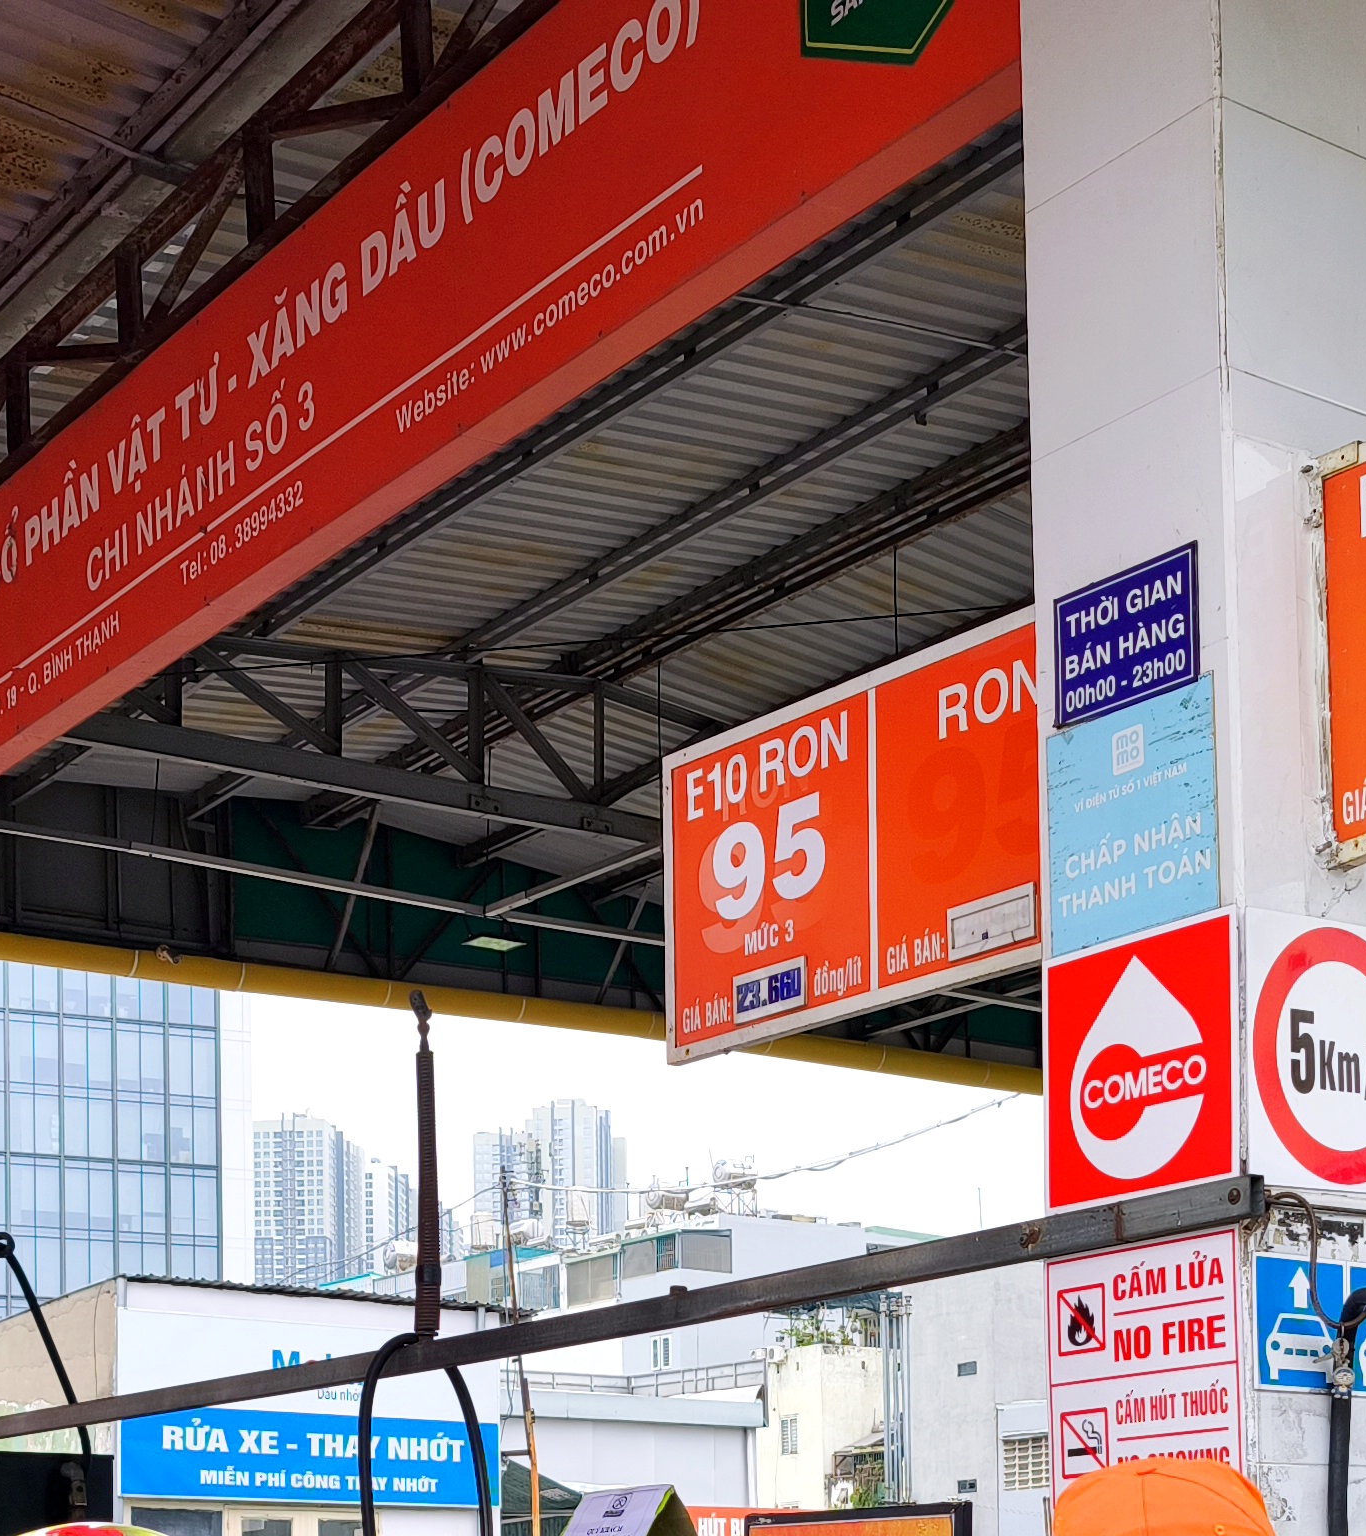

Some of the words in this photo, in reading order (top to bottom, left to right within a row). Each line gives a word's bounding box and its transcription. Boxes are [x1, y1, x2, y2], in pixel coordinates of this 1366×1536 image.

[24, 459, 100, 567] PHẦN
[107, 406, 167, 494] VẬT
[246, 262, 350, 390] XĂNG
[360, 181, 447, 298] DẦU
[460, 0, 702, 225] (COMECO)
[395, 362, 475, 434] Website:
[480, 196, 706, 376] www.comeco.com.vn
[86, 530, 130, 592] CHI
[136, 440, 235, 556] NHÁNH
[245, 377, 289, 472] SỐ
[297, 381, 316, 432] 3
[235, 480, 304, 548] 38994332
[1066, 596, 1119, 639] THỜI
[1125, 571, 1183, 616] GIAN
[6, 686, 17, 711] 19
[43, 650, 74, 686] BÌNH
[76, 611, 121, 661] THẠNH
[1065, 638, 1111, 679] BÁN
[1118, 611, 1186, 667] HÀNG
[938, 658, 1037, 741] RON
[1065, 675, 1116, 714] 00h00
[1132, 649, 1187, 692] 23h00
[687, 754, 747, 822] E10
[759, 710, 849, 793] RON
[712, 791, 827, 921] 95
[1065, 832, 1126, 879] CHẤP
[1134, 812, 1202, 857] NHẬN
[1058, 872, 1136, 918] THANH
[1143, 847, 1212, 889] TOÁN
[744, 922, 779, 956] MỨC
[785, 919, 794, 943] 3
[887, 936, 908, 977] GIÁ
[914, 929, 945, 967] BÁN:
[682, 1000, 702, 1035] GIÁ
[705, 991, 731, 1029] BÁN:
[814, 955, 862, 998] đồng/lít
[1083, 1053, 1208, 1111] COMECO
[1112, 1260, 1167, 1302] CẤM
[1175, 1250, 1224, 1292] LỬA
[1113, 1324, 1152, 1362] NO
[1162, 1313, 1227, 1356] FIRE
[1115, 1389, 1146, 1426] CẤM
[1150, 1388, 1177, 1421] HÚT
[1181, 1379, 1229, 1418] THUỐC
[162, 1417, 229, 1453] RỬA
[238, 1429, 280, 1456] XE
[388, 1431, 465, 1463] NHỚT
[200, 1464, 250, 1488] MIỄN
[254, 1468, 287, 1488] PHÍ
[290, 1470, 341, 1490] CÔNG
[392, 1474, 439, 1494] NHỚT
